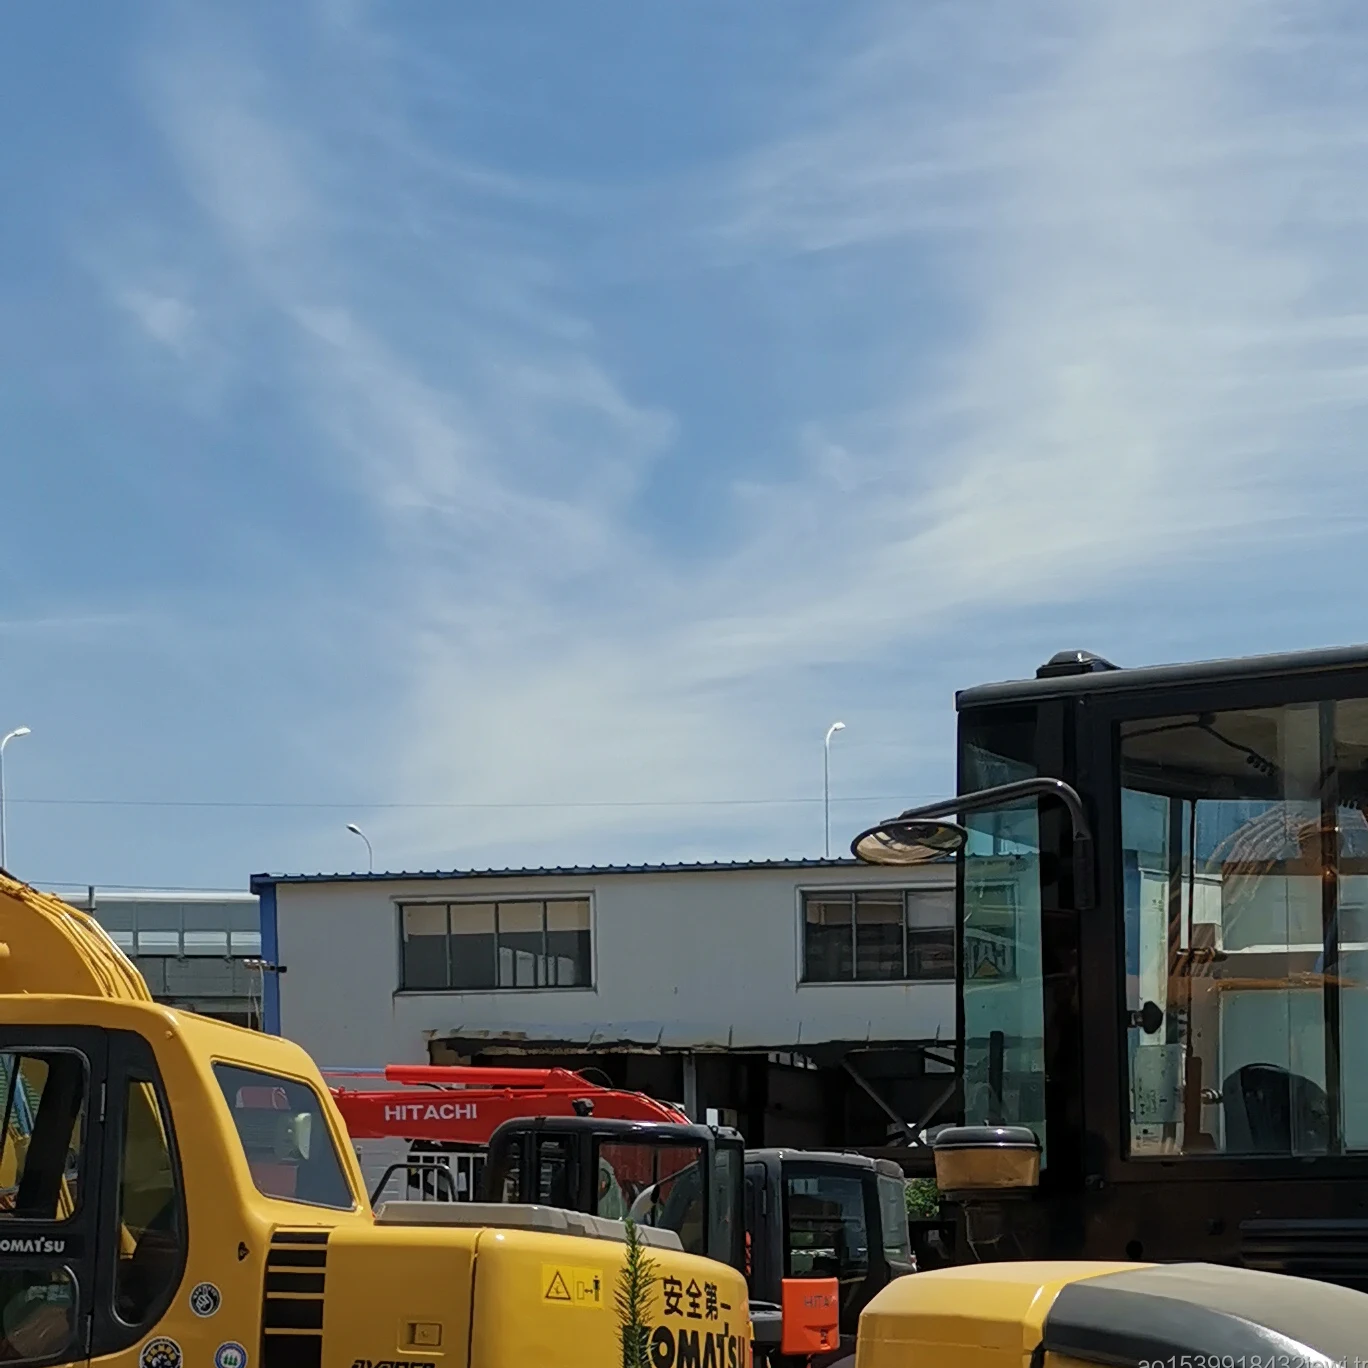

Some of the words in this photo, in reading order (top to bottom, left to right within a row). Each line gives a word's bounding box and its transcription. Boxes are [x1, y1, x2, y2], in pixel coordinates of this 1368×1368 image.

[384, 1103, 477, 1120] HITACHI
[0, 1236, 65, 1253] OMATSU
[663, 1275, 731, 1320] 安全第一
